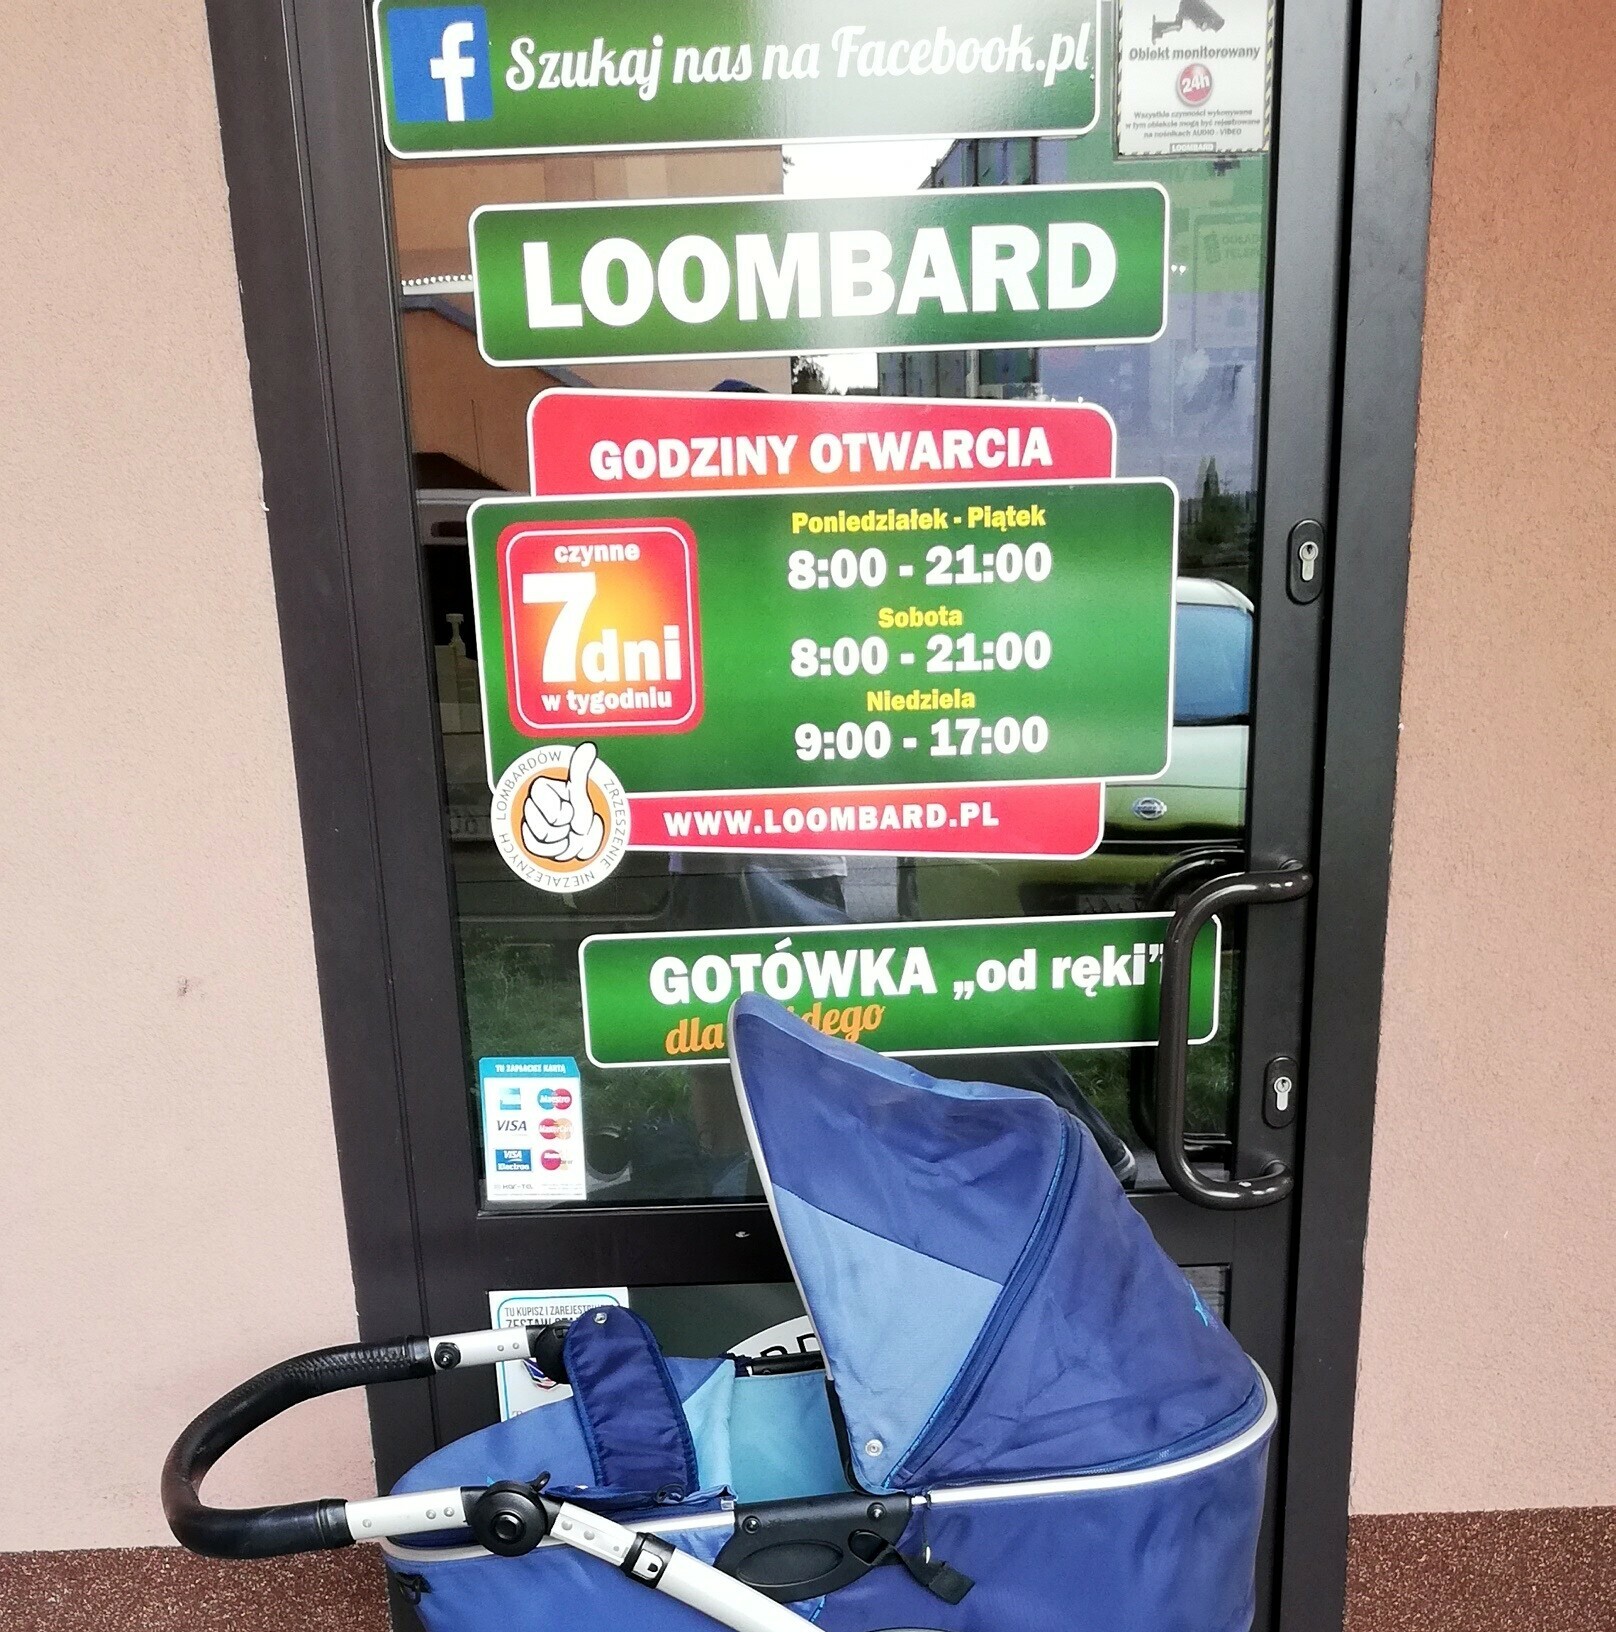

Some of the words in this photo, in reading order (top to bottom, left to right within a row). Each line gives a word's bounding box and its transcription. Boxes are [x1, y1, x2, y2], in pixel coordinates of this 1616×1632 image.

[505, 35, 663, 101] Szukaj
[672, 42, 752, 84] nas
[762, 42, 819, 80] na
[831, 22, 1091, 87] Facebook.pl
[1128, 46, 1169, 61] Obiekt
[1172, 45, 1261, 60] monitorowany
[1181, 75, 1210, 93] 24h
[1192, 129, 1215, 137] AUDIO
[1220, 128, 1242, 136] VIDEO
[1171, 143, 1214, 152] LOOMBARD
[523, 222, 1117, 328] LOOMBARD
[589, 433, 798, 482] GODZINY
[810, 427, 1053, 473] OTWARCIA
[791, 508, 949, 534] Poniedziałek
[967, 505, 1046, 532] Piątek
[554, 543, 641, 566] czynne
[787, 548, 888, 590] 8:00
[925, 542, 1053, 586] 21:00
[878, 606, 963, 629] Sobota
[790, 636, 889, 678] 8:00
[926, 631, 1052, 673] 21:00
[541, 692, 563, 711] w
[566, 687, 673, 715] tygodniu
[866, 688, 976, 712] Niedziela
[794, 720, 891, 761] 9:00
[930, 715, 1049, 758] 17:00
[496, 750, 562, 820] LOMBARDÓW
[600, 778, 627, 869] ZRZESZENIE
[663, 801, 1000, 838] WWW.LOOMBARD.PL
[499, 833, 595, 888] NIEZALEŻNYCH
[650, 936, 938, 1005] GOTÓWKA
[665, 1017, 725, 1055] dla
[787, 1002, 886, 1043] dego
[540, 1095, 571, 1104] Maestro
[497, 1120, 527, 1131] VISA
[497, 1163, 530, 1171] Electron
[503, 1150, 522, 1159] VISA
[504, 1307, 515, 1317] TU
[517, 1305, 544, 1316] KUPISZ
